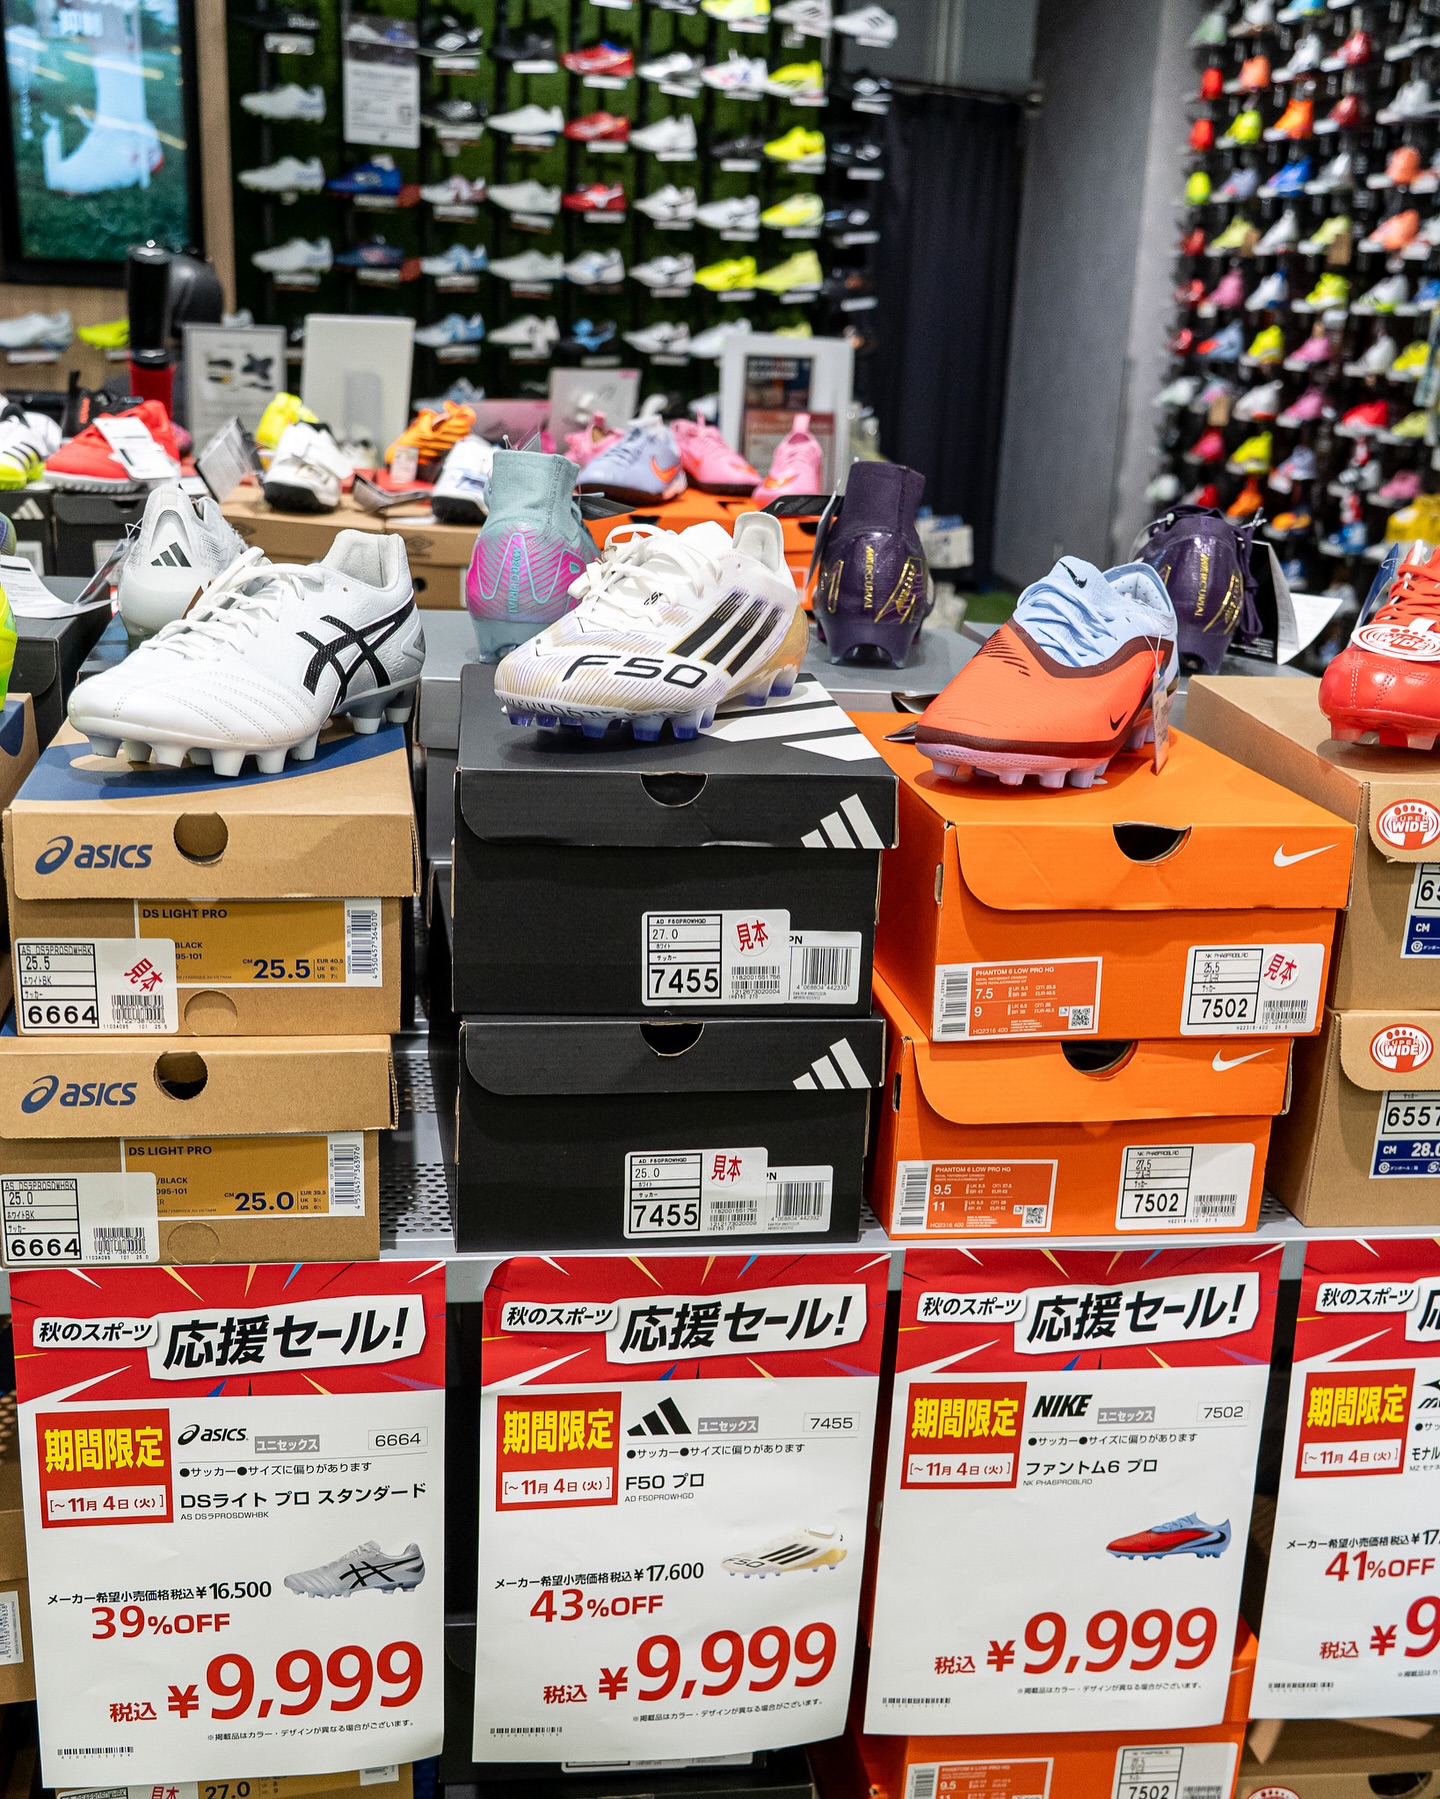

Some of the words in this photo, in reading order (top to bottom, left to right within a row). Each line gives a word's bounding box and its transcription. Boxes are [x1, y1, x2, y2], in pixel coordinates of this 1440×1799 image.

[562, 654, 708, 688] F50
[1391, 821, 1429, 833] WIDE
[143, 909, 159, 919] DS
[162, 909, 199, 919] LIGHT
[202, 909, 228, 918] PRO
[652, 928, 679, 940] 27.0
[736, 920, 769, 952] 見本
[1416, 923, 1430, 932] CM
[26, 956, 50, 970] 25.5
[253, 959, 310, 979] 25.5
[1203, 962, 1220, 973] 25.5
[1264, 953, 1297, 985] 見本
[124, 958, 163, 992] 見本
[651, 968, 719, 994] 7455
[975, 988, 993, 999] 7.5
[28, 1005, 98, 1024] 6664
[974, 1006, 982, 1017] 9
[1202, 998, 1248, 1019] 7502
[1384, 1045, 1419, 1056] WIDE
[129, 1147, 145, 1156] DS
[148, 1146, 184, 1156] LIGHT
[188, 1146, 212, 1155] PRO
[1383, 1145, 1397, 1154] CM
[635, 1168, 660, 1178] 25.0
[711, 1155, 742, 1182] 見本
[1136, 1160, 1151, 1171] 27.5
[9, 1192, 33, 1206] 25.0
[934, 1184, 951, 1195] 9.5
[234, 1191, 294, 1211] 25.0
[933, 1201, 945, 1212] 11
[1134, 1193, 1179, 1213] 7502
[633, 1203, 698, 1227] 7455
[11, 1238, 81, 1257] 6664
[1321, 1287, 1415, 1307] 秋のスポーツ
[922, 1297, 1021, 1316] 秋のスポーツ
[1027, 1284, 1246, 1343] 応援セール!
[506, 1307, 614, 1327] 秋のスポーツ
[619, 1296, 853, 1354] 応援セール!
[39, 1322, 152, 1343] 秋のスポーツ
[163, 1307, 410, 1370] 応援セール!
[1032, 1394, 1093, 1418] NIKE
[1203, 1406, 1244, 1420] 7502
[1307, 1383, 1408, 1428] 期間限定
[810, 1417, 853, 1430] 7455
[911, 1397, 1019, 1439] 期間限定
[1099, 1409, 1154, 1423] ユニセックス
[503, 1408, 614, 1455] 期間限定
[699, 1420, 757, 1433] ユニセックス
[45, 1426, 164, 1473] 期間限定
[256, 1438, 318, 1451] ユニセックス
[375, 1433, 421, 1447] 6664
[1026, 1460, 1120, 1476] ファントム6
[1127, 1458, 1158, 1474] プロ
[626, 1475, 665, 1490] F50
[672, 1472, 705, 1489] プロ
[181, 1492, 267, 1509] DSライト
[275, 1490, 310, 1507] プロ
[318, 1482, 427, 1505] スタンダード
[625, 1494, 636, 1502] AD
[181, 1512, 193, 1521] AS
[1325, 1550, 1435, 1582] 41%OFF
[529, 1588, 664, 1622] 43%OFF
[91, 1605, 230, 1639] 39%OFF
[934, 1656, 976, 1675] 税込
[986, 1607, 1218, 1675] ¥9,999
[1320, 1641, 1359, 1660] 税込
[543, 1684, 587, 1704] 税込
[599, 1622, 837, 1701] ¥9,999
[109, 1702, 157, 1722] 税込
[168, 1641, 424, 1720] ¥9,999
[205, 1781, 250, 1799] 27.0
[940, 1780, 956, 1790] 9.5
[1129, 1785, 1170, 1799] 7502
